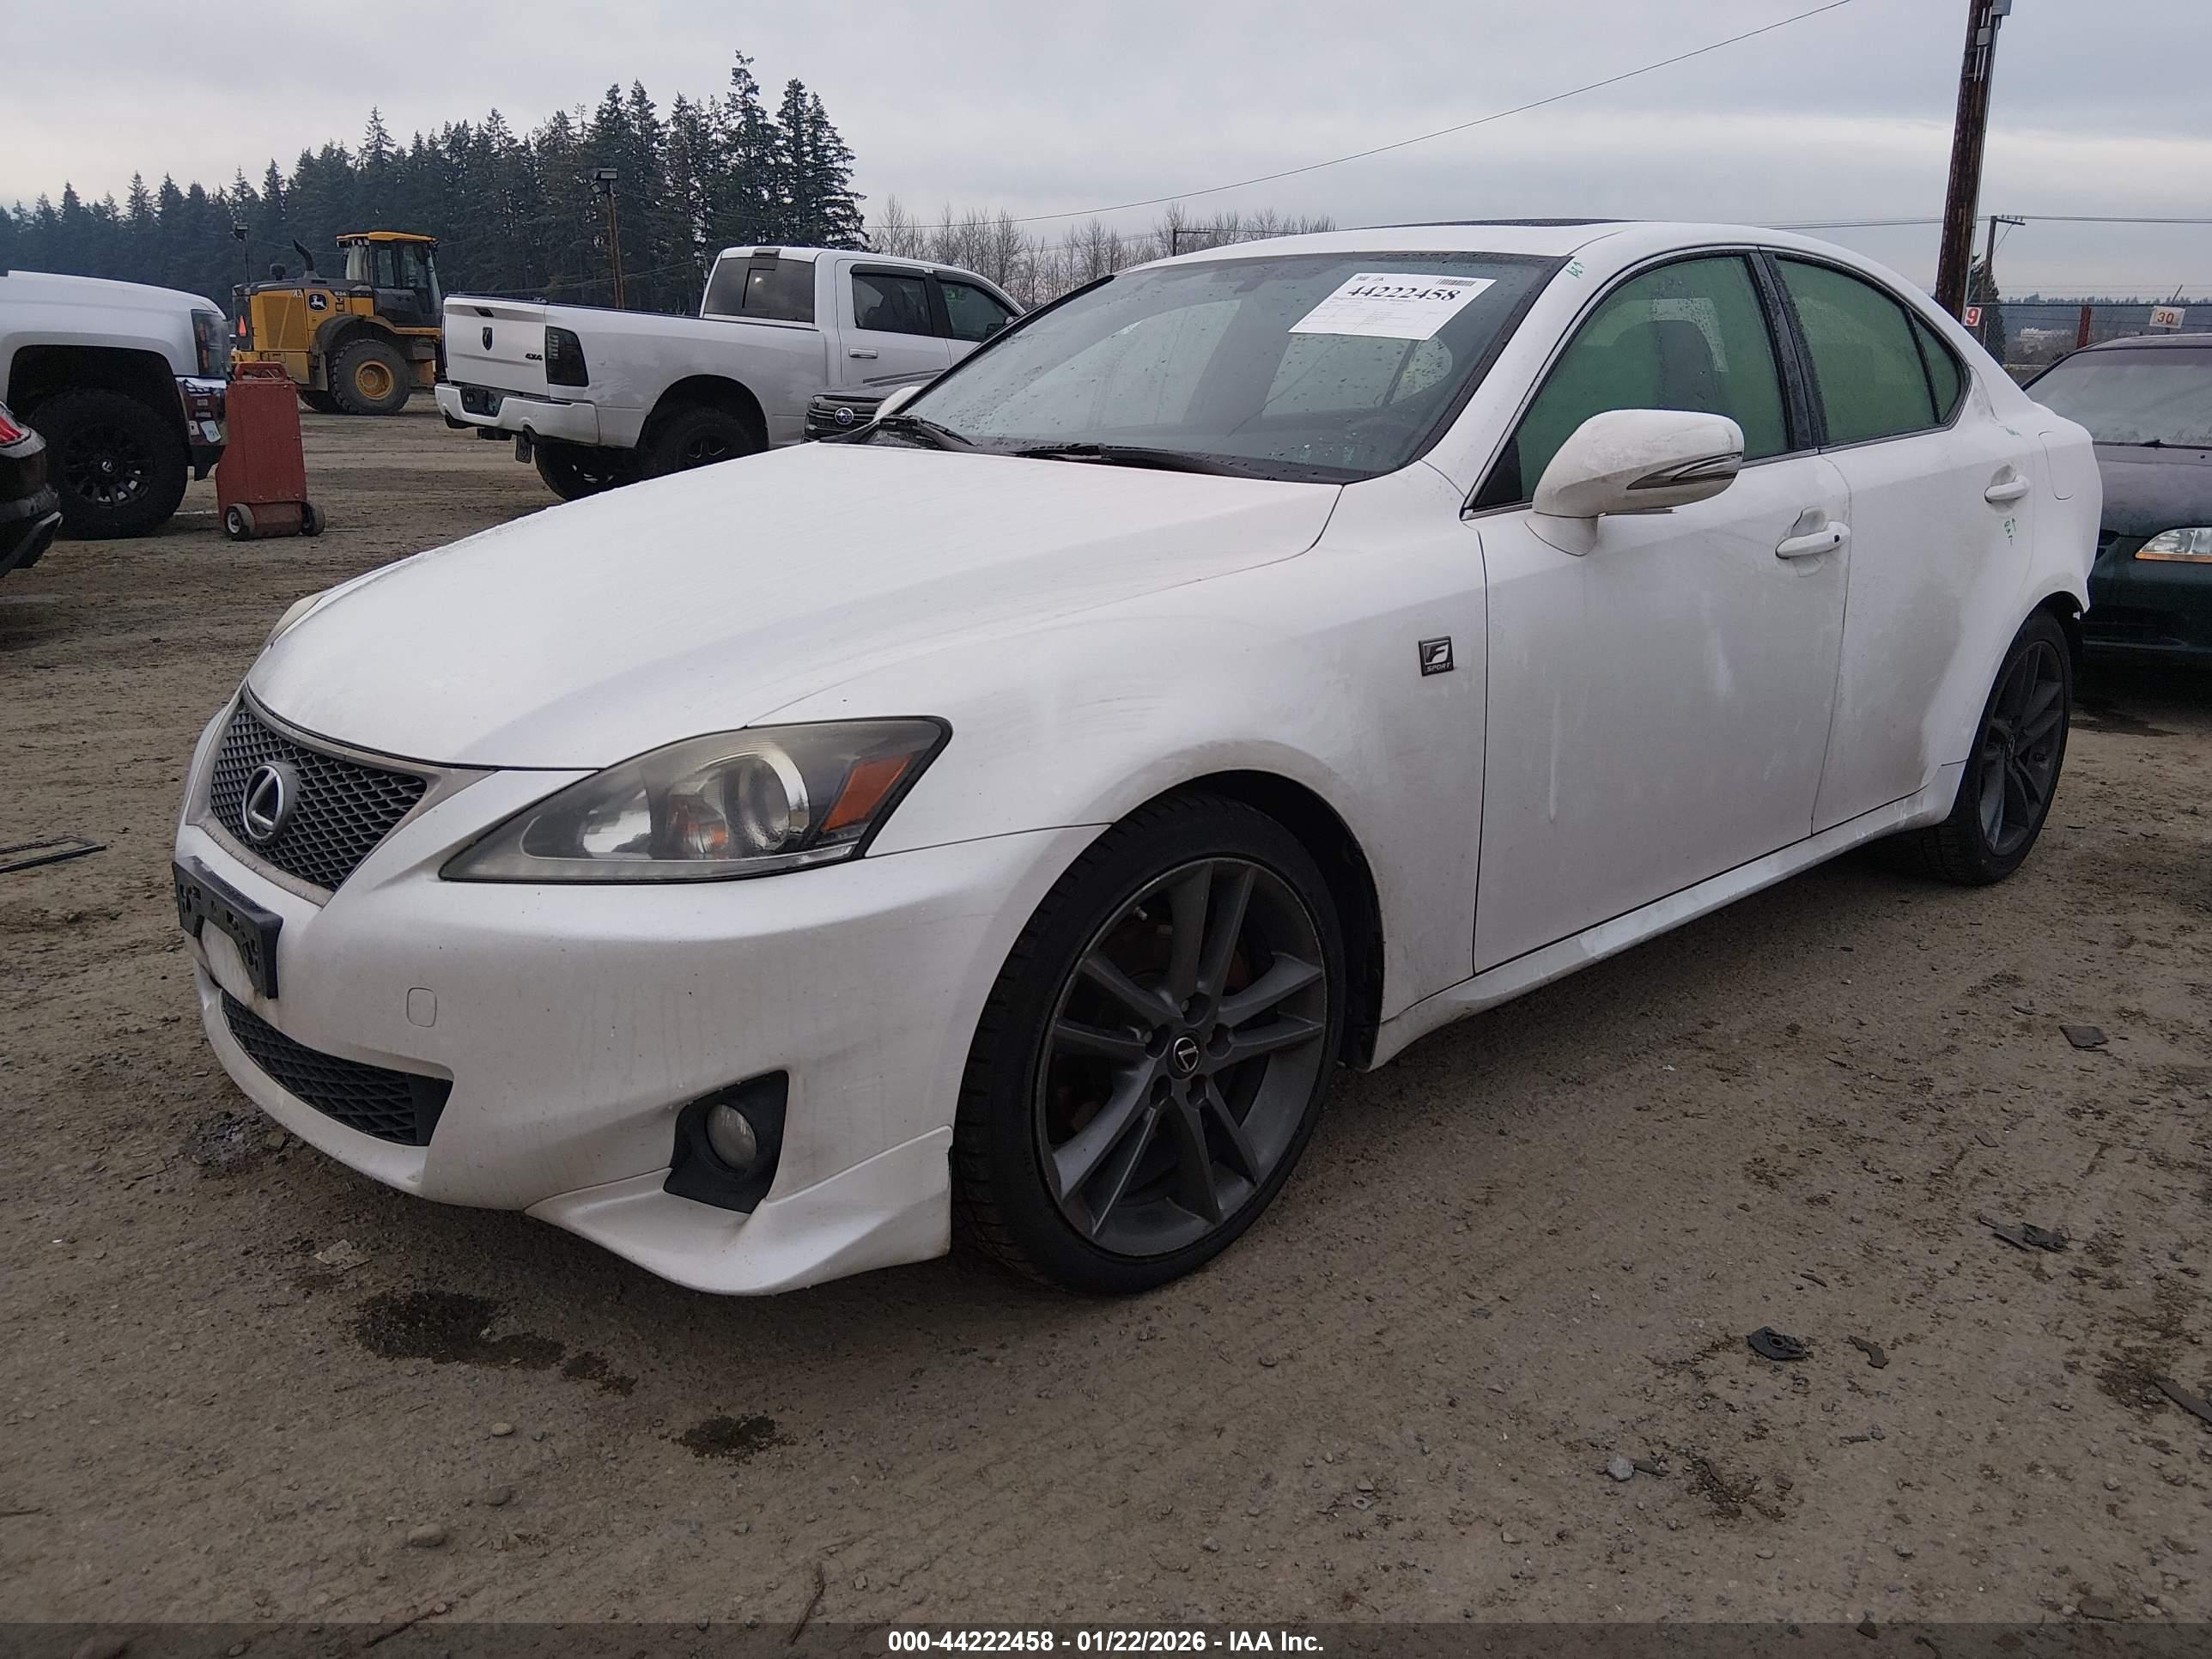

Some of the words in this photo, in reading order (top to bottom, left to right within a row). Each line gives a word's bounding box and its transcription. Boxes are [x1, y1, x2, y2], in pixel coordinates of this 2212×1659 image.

[1346, 285, 1462, 301] 44222458
[1966, 307, 1979, 325] 9
[2156, 312, 2174, 324] 30
